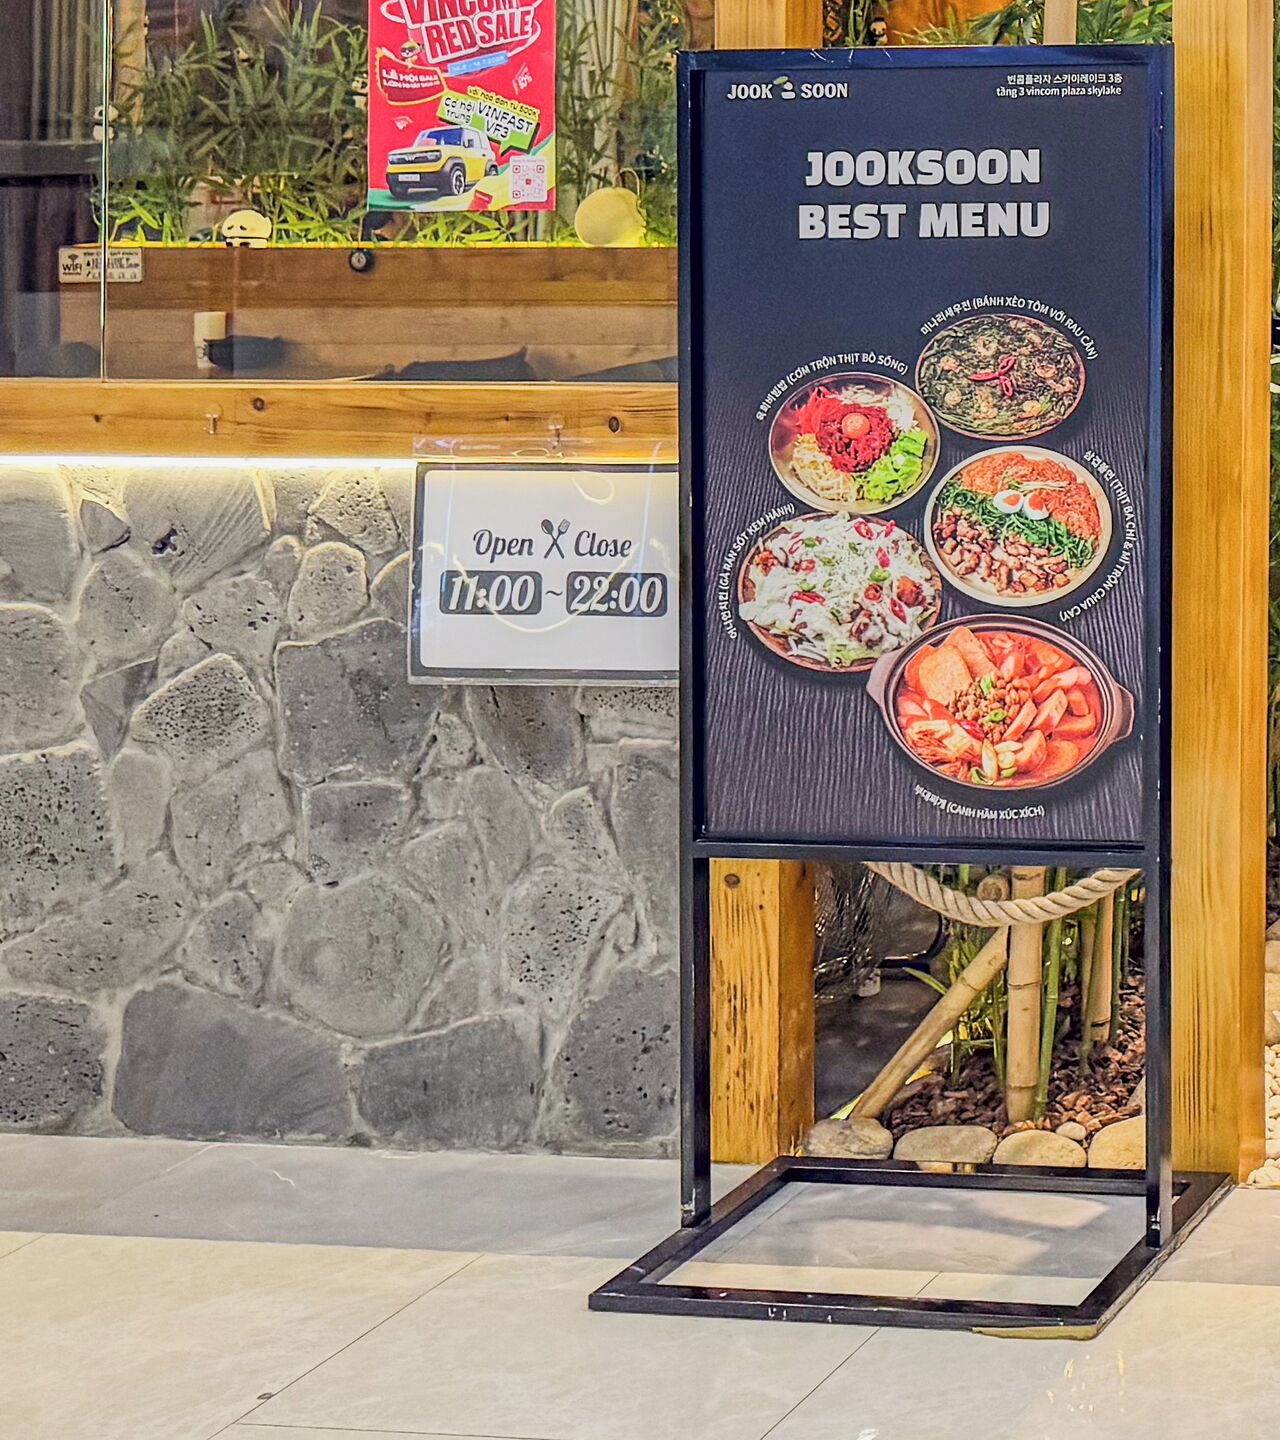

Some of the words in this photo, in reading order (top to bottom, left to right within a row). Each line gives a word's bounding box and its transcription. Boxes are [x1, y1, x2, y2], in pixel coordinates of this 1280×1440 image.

[425, 19, 477, 59] RED
[477, 10, 533, 46] SALE
[727, 84, 773, 99] JOOK
[801, 82, 848, 99] SOON
[1019, 86, 1025, 96] 3
[1026, 86, 1060, 96] vincom
[1061, 86, 1086, 97] plaza
[1087, 85, 1122, 97] skylake
[478, 101, 534, 133] VINFAST
[486, 119, 510, 138] VF3
[805, 149, 1040, 186] JOOKSOON
[799, 203, 906, 239] BEST
[919, 202, 1050, 238] MENU
[920, 300, 971, 335] 미나리새우전
[973, 295, 1004, 309] (BÁNH
[1005, 296, 1026, 308] XÈO
[1027, 299, 1050, 315] TÔM
[1050, 307, 1066, 322] VỚI
[1064, 318, 1085, 337] RAU
[786, 365, 811, 386] (CƠM
[809, 355, 837, 372] TRỘN
[837, 352, 861, 365] THỊT
[861, 351, 877, 363] BÒ
[877, 354, 909, 376] SỐNG)
[1110, 478, 1130, 505] (THỊT
[1123, 504, 1136, 520] BA
[473, 529, 534, 564] Open
[574, 530, 632, 558] Close
[723, 548, 738, 573] RÁN
[733, 530, 751, 553] SỐT
[747, 517, 767, 538] KEM
[765, 503, 795, 523] HÀNH)
[1105, 564, 1126, 592] TRỘN
[448, 574, 535, 611] 11:00
[570, 575, 663, 613] 22:00
[1081, 589, 1107, 613] CHUA
[1059, 604, 1082, 623] CAY)
[946, 801, 976, 819] (CANH
[999, 806, 1019, 820] XÚC
[1020, 805, 1045, 819] XÍCH)
